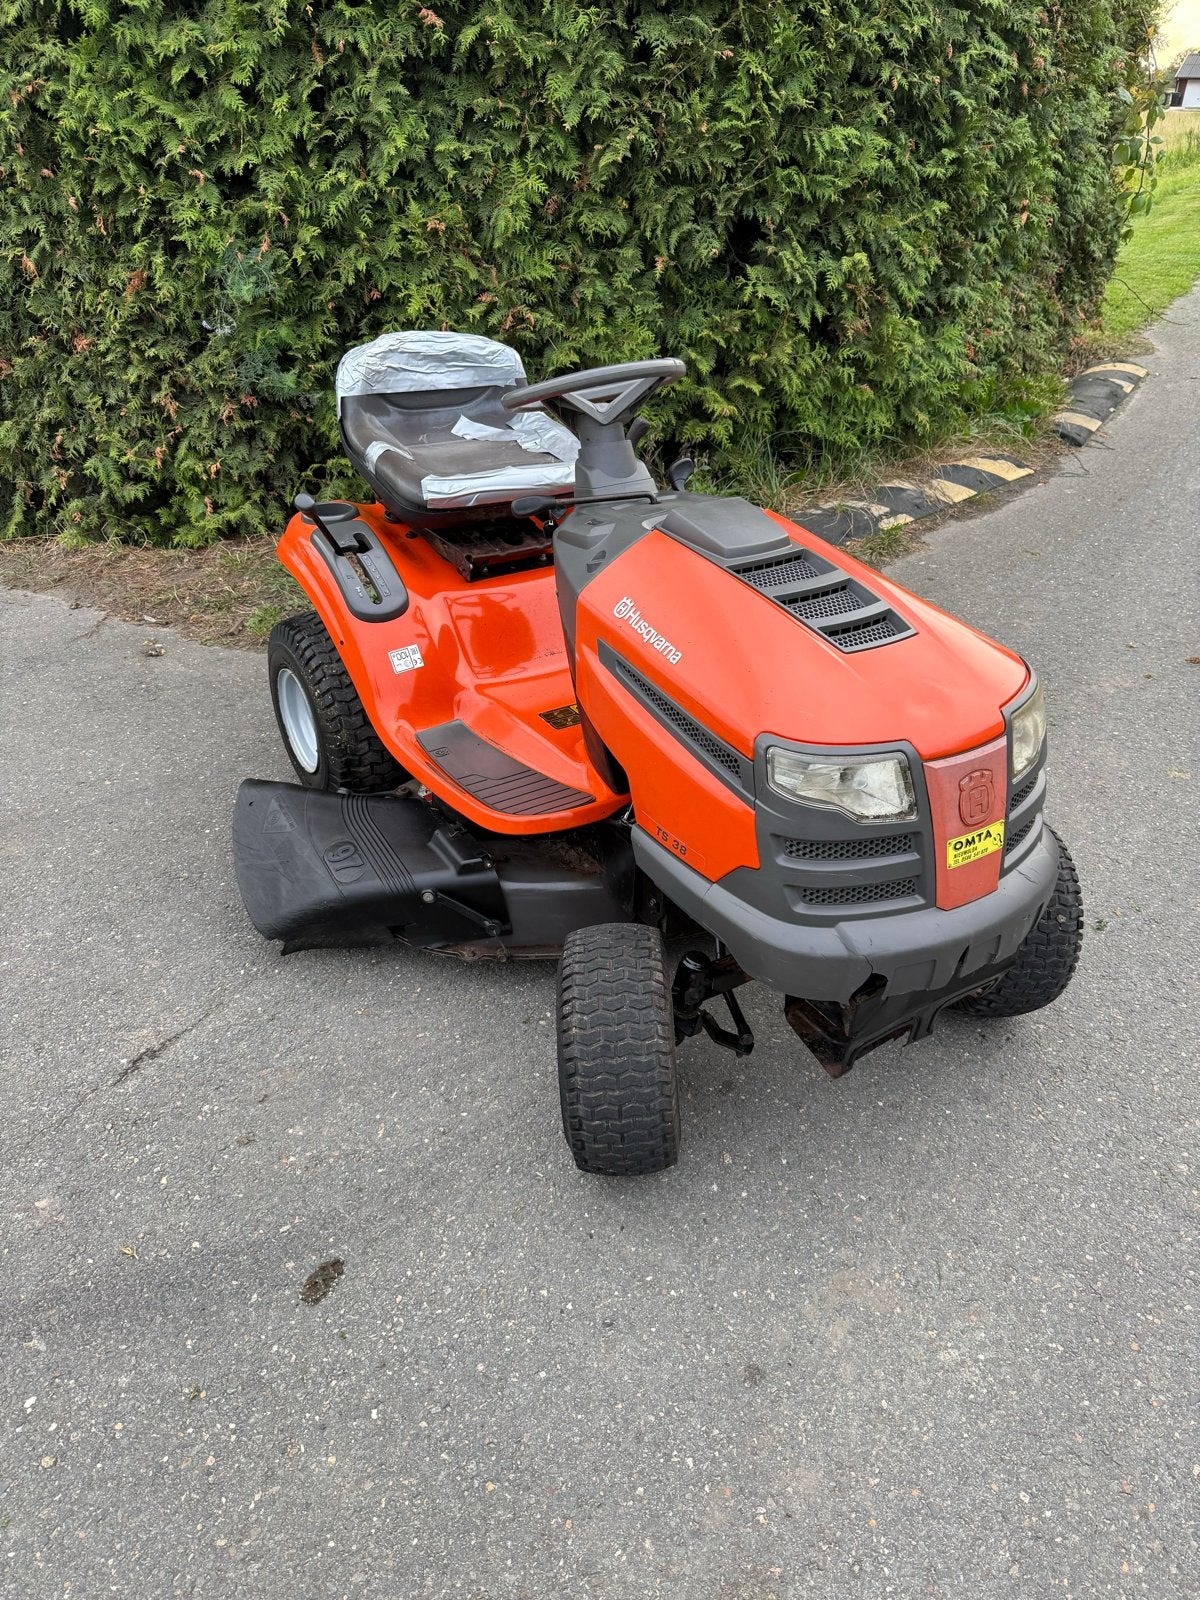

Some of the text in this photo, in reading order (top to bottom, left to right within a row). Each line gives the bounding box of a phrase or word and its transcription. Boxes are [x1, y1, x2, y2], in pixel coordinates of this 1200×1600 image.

[624, 607, 682, 664] Husqvarna
[656, 826, 687, 855] TS 38
[953, 829, 992, 851] OMTA
